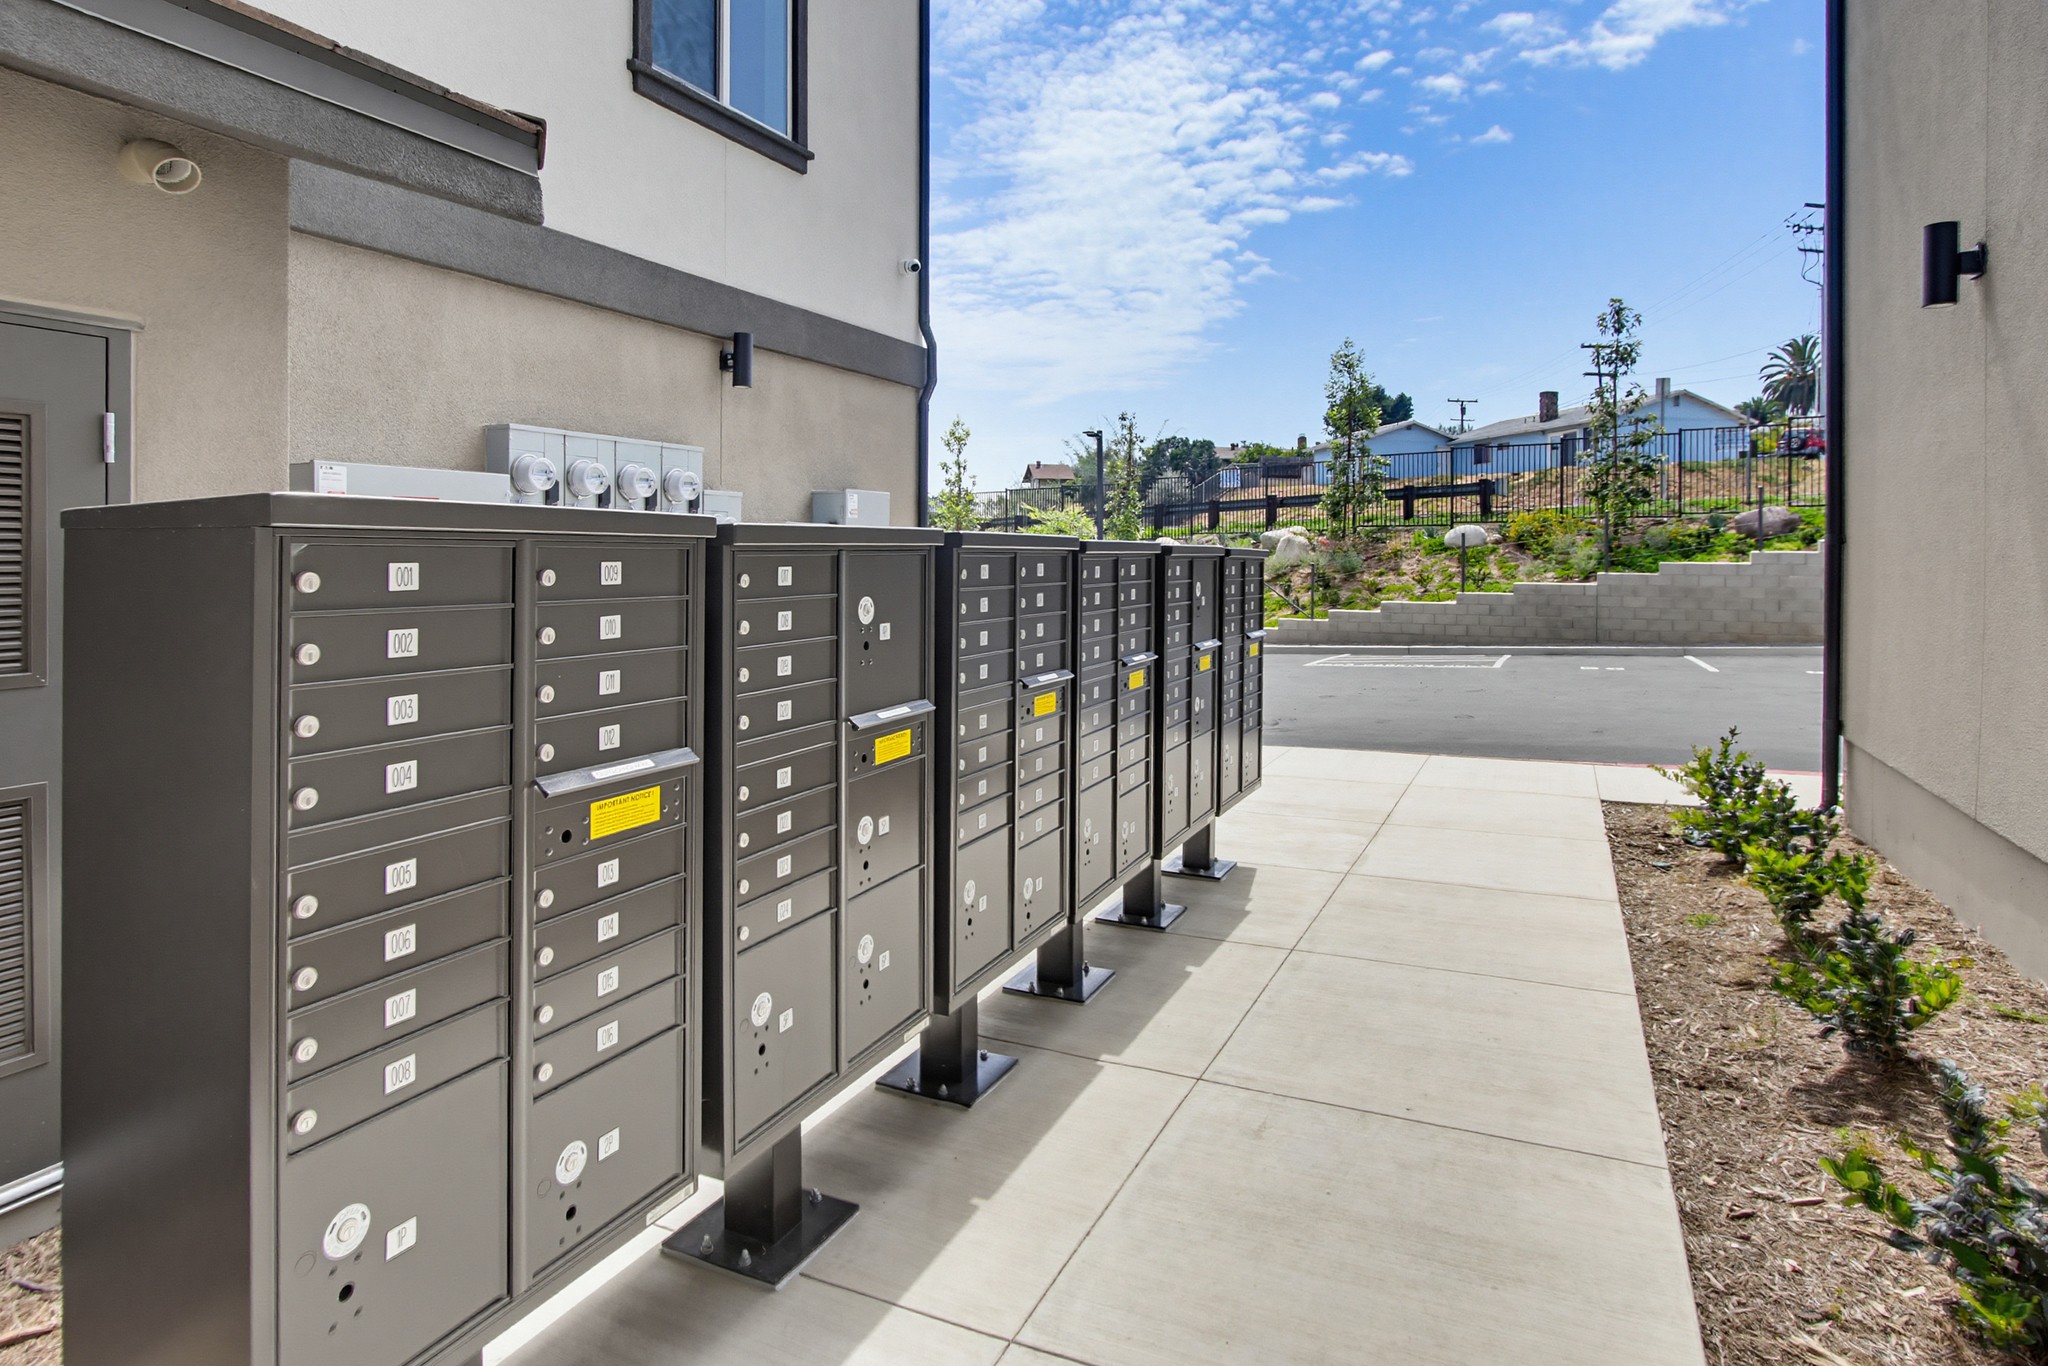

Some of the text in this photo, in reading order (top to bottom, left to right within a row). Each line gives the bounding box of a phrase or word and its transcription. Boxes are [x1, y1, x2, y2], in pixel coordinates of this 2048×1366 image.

[396, 566, 413, 587] 001
[604, 564, 618, 582] 009
[604, 618, 617, 636] 010
[393, 632, 413, 654] 002
[605, 673, 615, 691] 011
[392, 698, 414, 721] 003
[603, 728, 615, 747] 012
[392, 764, 412, 788] 004
[596, 796, 630, 811] IMPORTANT
[391, 863, 411, 888] 005
[602, 862, 615, 882] 013
[602, 916, 614, 937] 014
[391, 929, 411, 954] 006
[601, 970, 614, 992] 015
[391, 994, 411, 1020] 007
[601, 1025, 614, 1046] 016
[391, 1059, 411, 1087] 008
[397, 1226, 407, 1249] 1P
